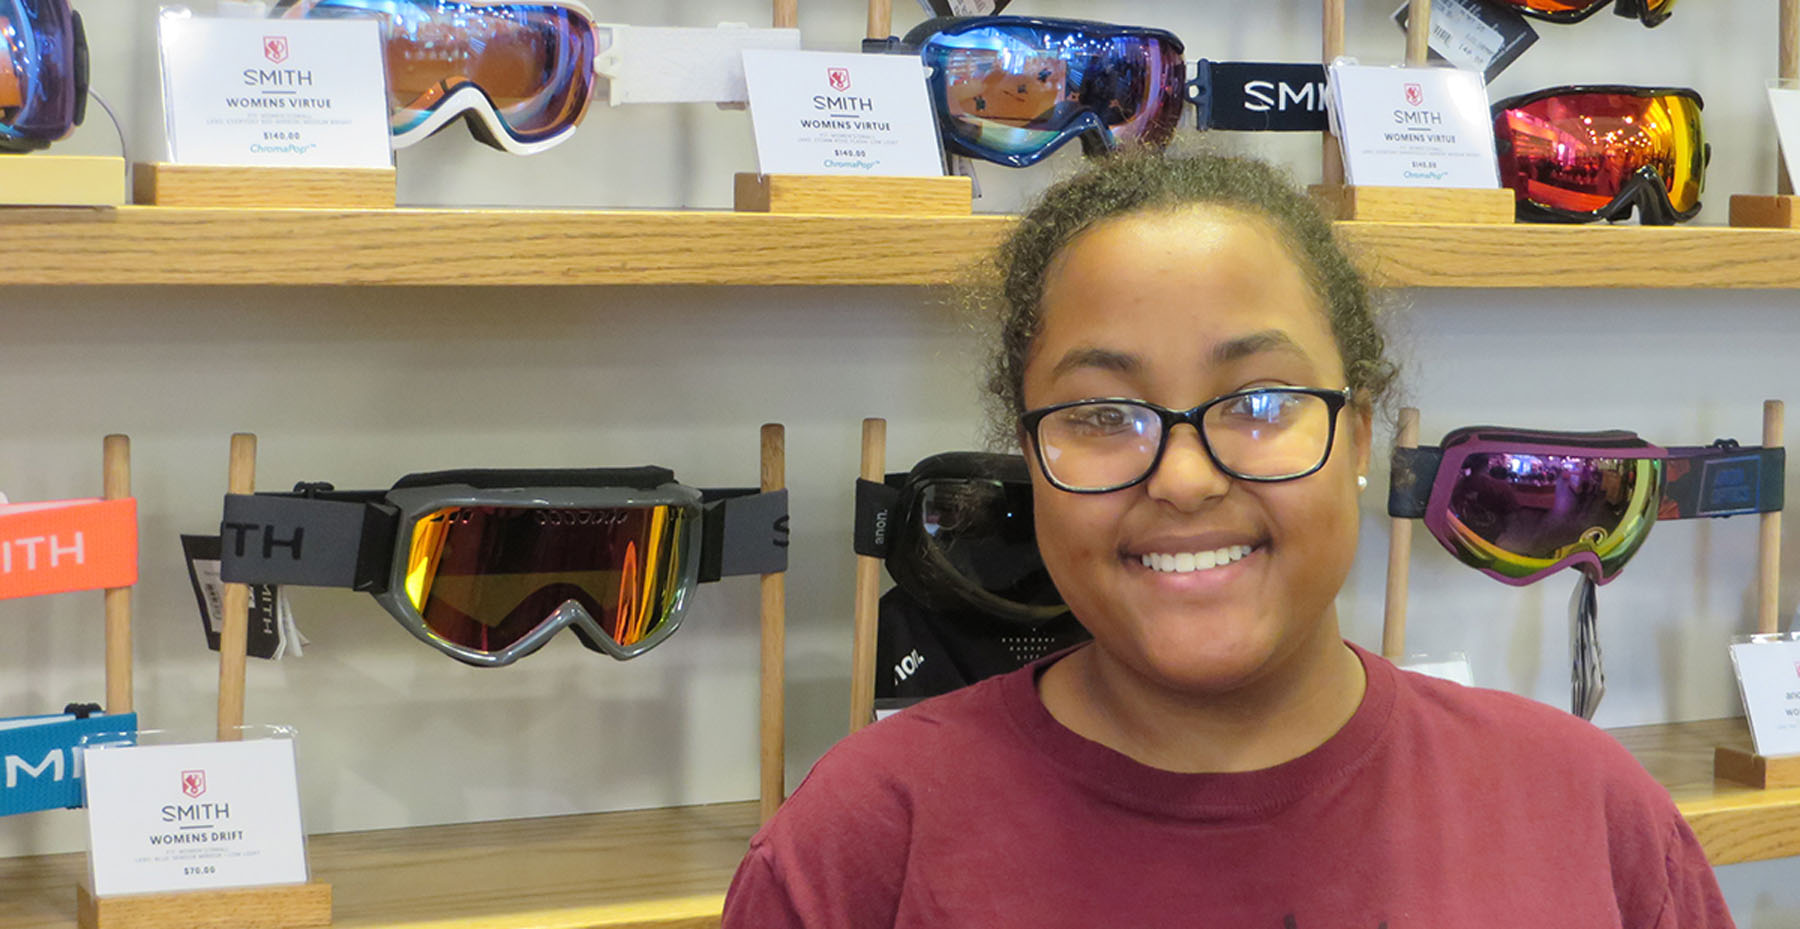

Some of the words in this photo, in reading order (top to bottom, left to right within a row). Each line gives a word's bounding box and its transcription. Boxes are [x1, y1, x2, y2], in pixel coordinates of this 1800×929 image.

[243, 69, 312, 86] SMITH
[226, 97, 286, 108] WOMENS
[289, 98, 332, 109] VIRTUE
[813, 95, 873, 111] SMITH
[1393, 109, 1442, 124] SMITH
[800, 120, 852, 130] WOMENS
[854, 121, 891, 131] VIRTUE
[1384, 132, 1426, 143] WOMENS
[1428, 133, 1456, 143] VIRTUE
[875, 508, 888, 545] anon.
[161, 803, 230, 822] SMITH
[149, 832, 208, 845] WOMENS
[211, 830, 243, 842] DRIFT
[184, 866, 216, 875] $70.00
